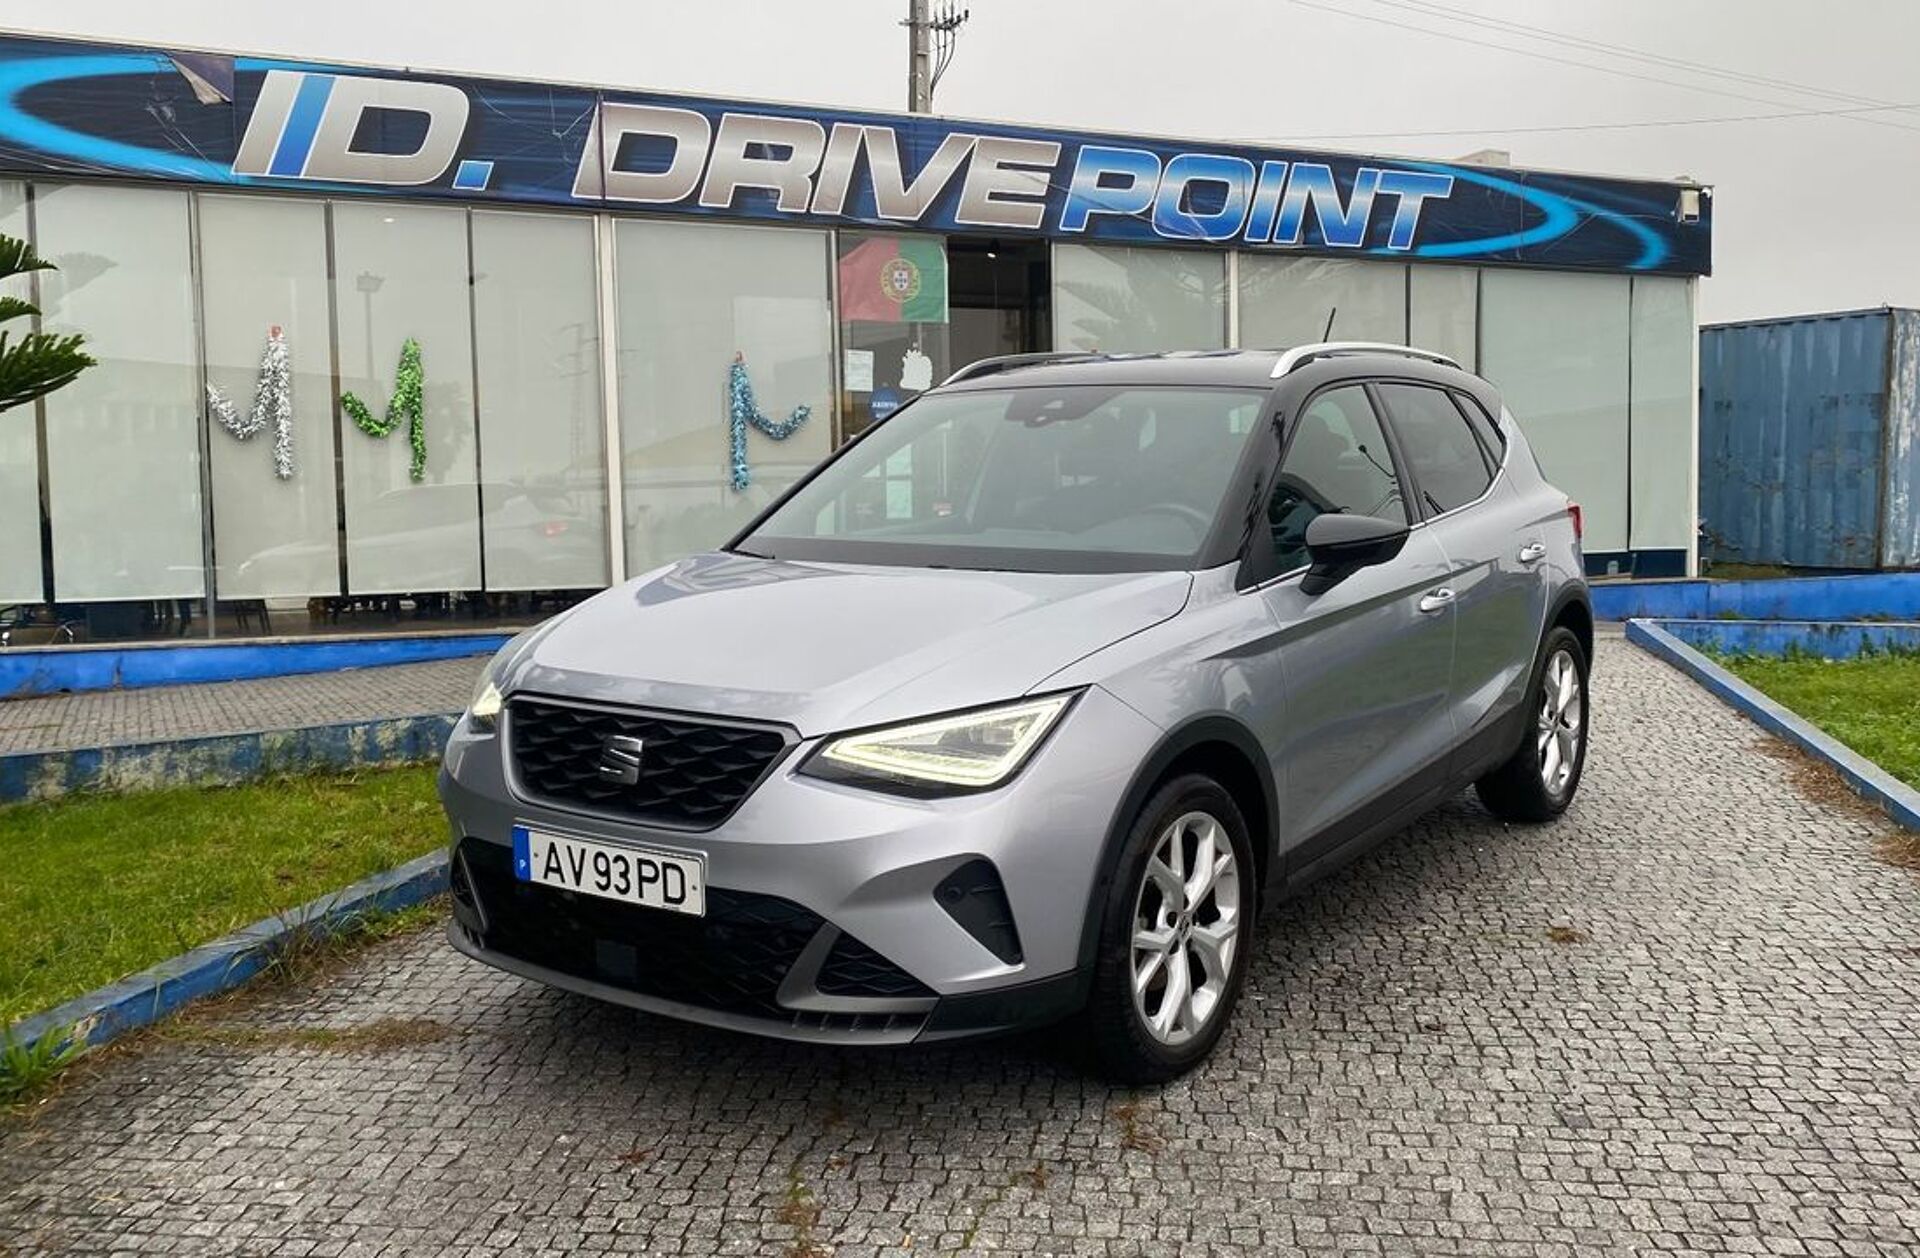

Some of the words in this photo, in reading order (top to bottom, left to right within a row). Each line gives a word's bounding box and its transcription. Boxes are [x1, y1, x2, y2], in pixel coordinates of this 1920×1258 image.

[231, 69, 494, 191] ID.
[571, 101, 1062, 229] DRIVE
[1059, 144, 1455, 250] POINT
